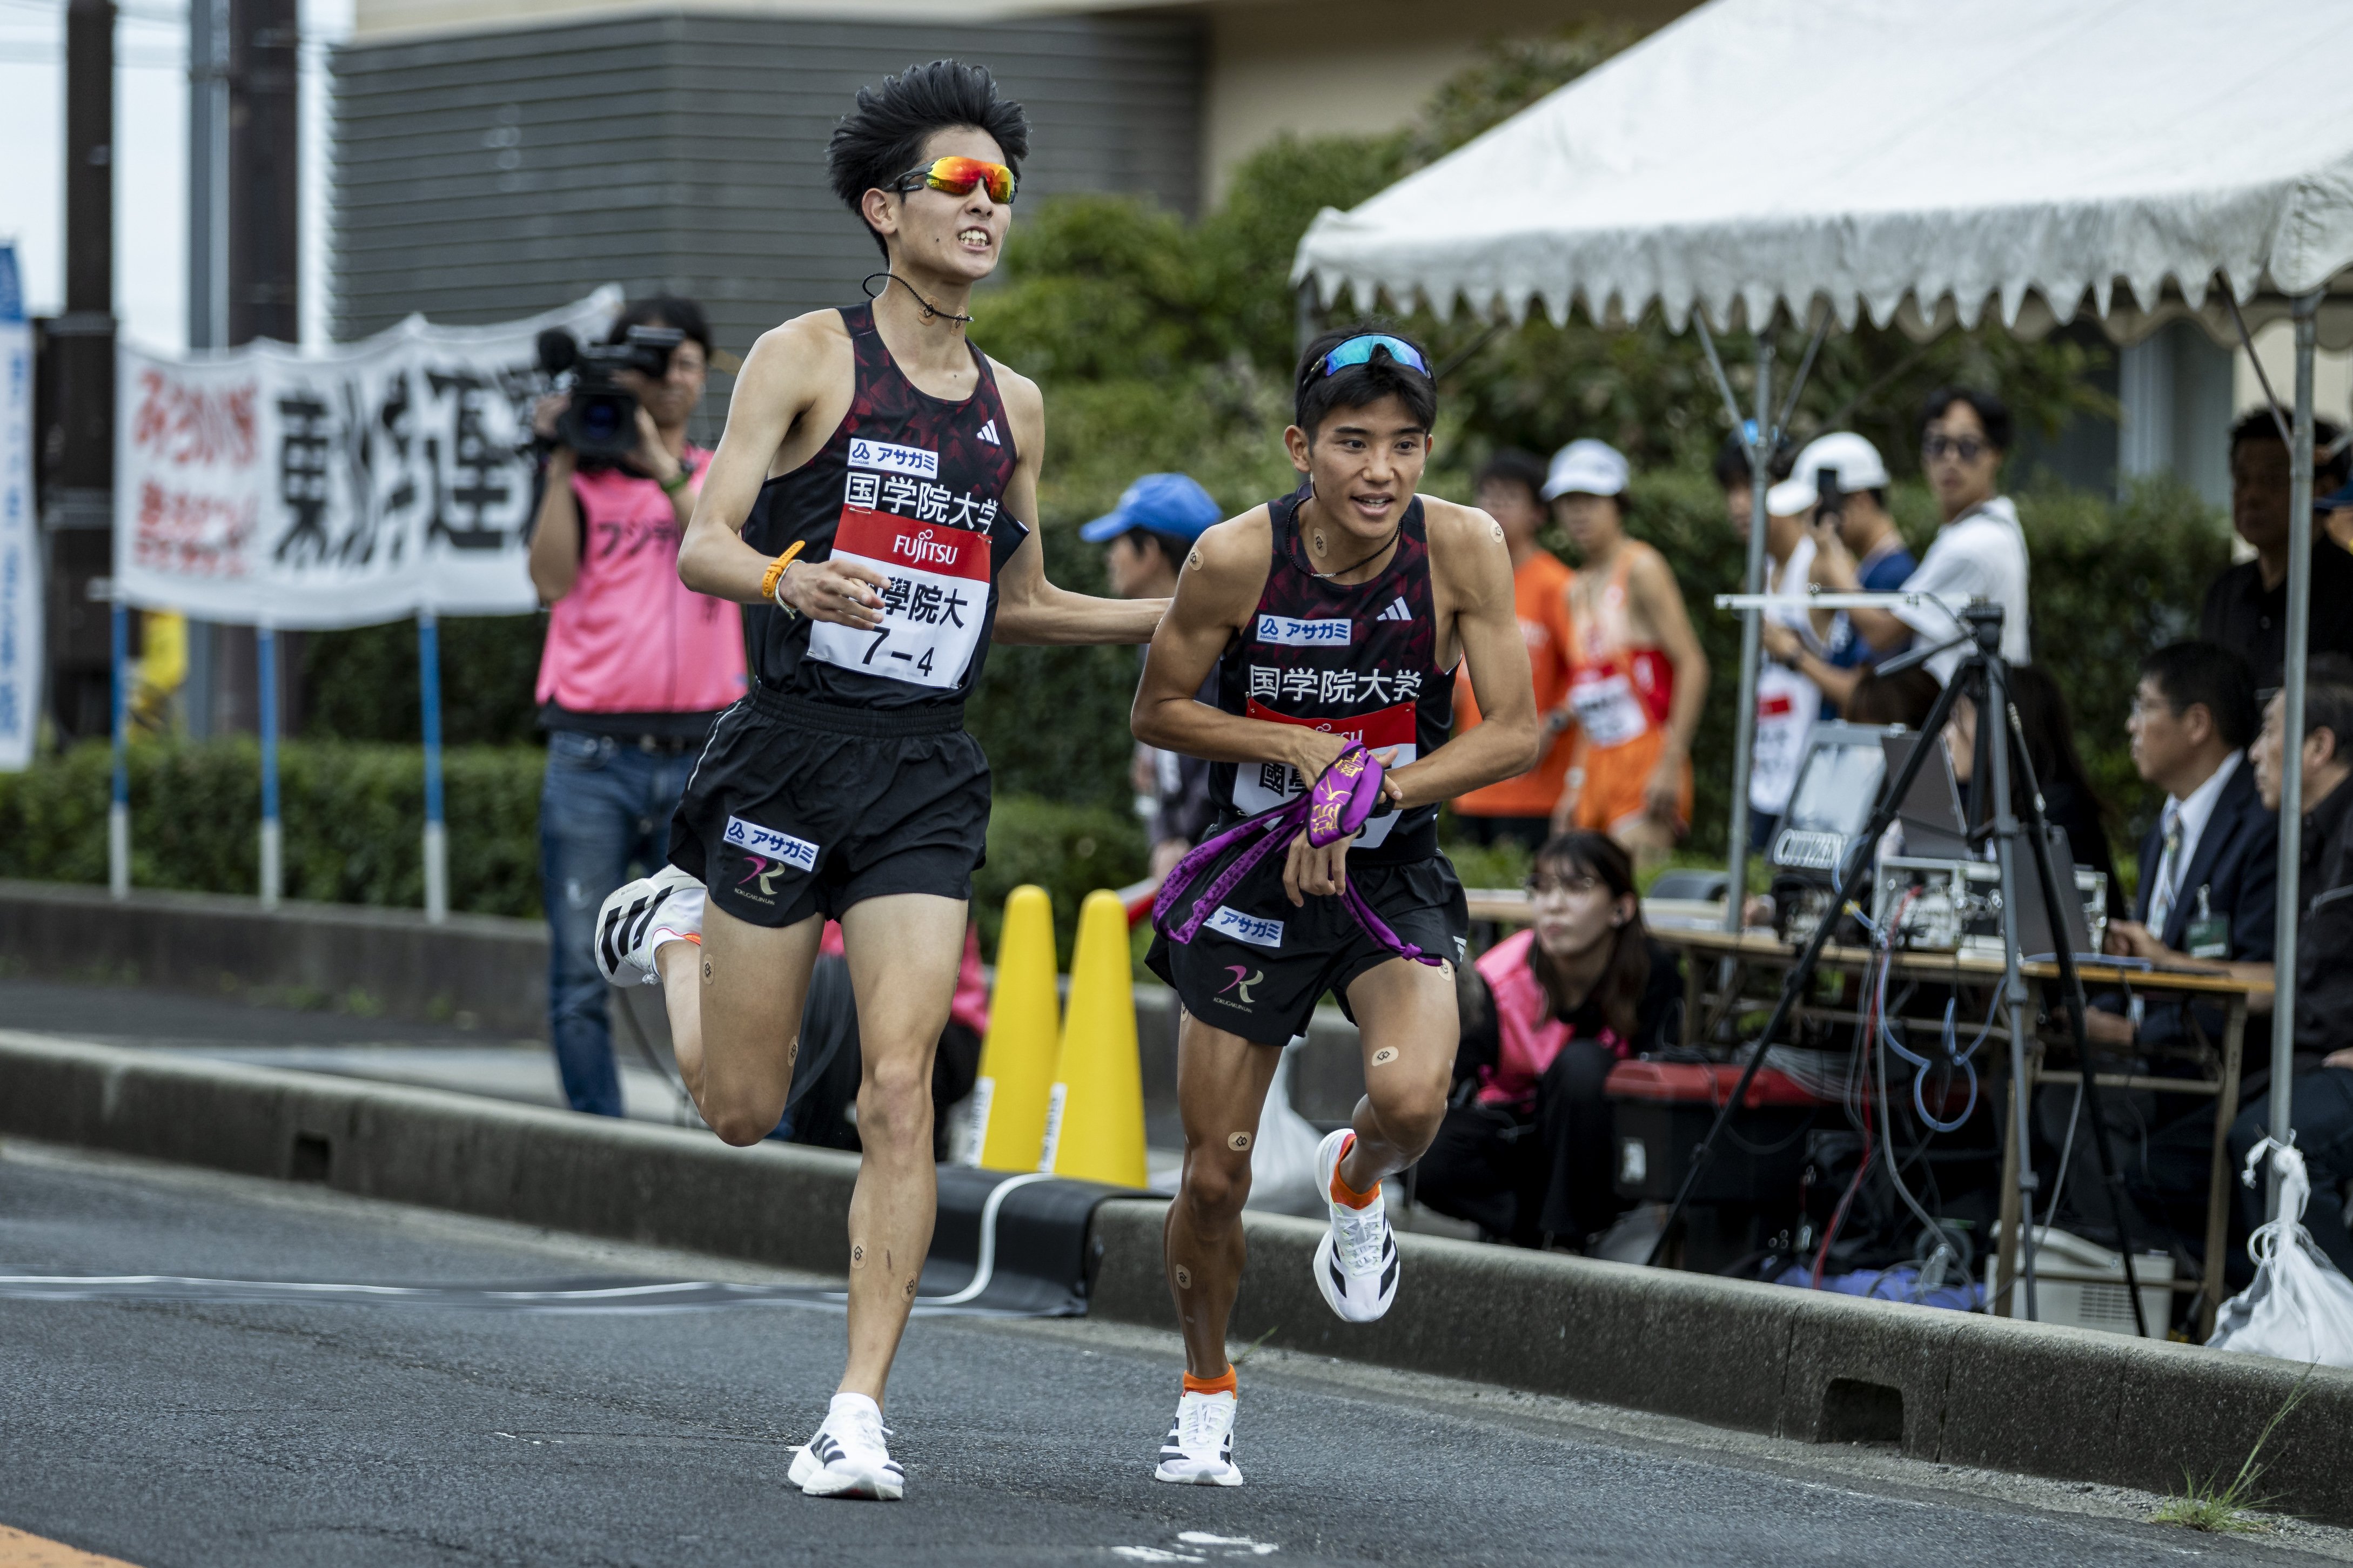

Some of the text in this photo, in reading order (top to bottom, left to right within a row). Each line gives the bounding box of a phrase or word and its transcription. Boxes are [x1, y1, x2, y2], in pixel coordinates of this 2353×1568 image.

[877, 446, 935, 472] アサガミ
[893, 529, 958, 564] FUJITSU
[866, 576, 968, 629] 學院大
[1286, 622, 1348, 640] アサガミ
[1250, 664, 1422, 704] 国学院大学
[751, 830, 814, 864] アサガミ
[734, 887, 765, 903] KOKUGAKUIN
[1221, 911, 1280, 940] アサガミ
[1214, 997, 1244, 1010] KOKUGAKUIN
